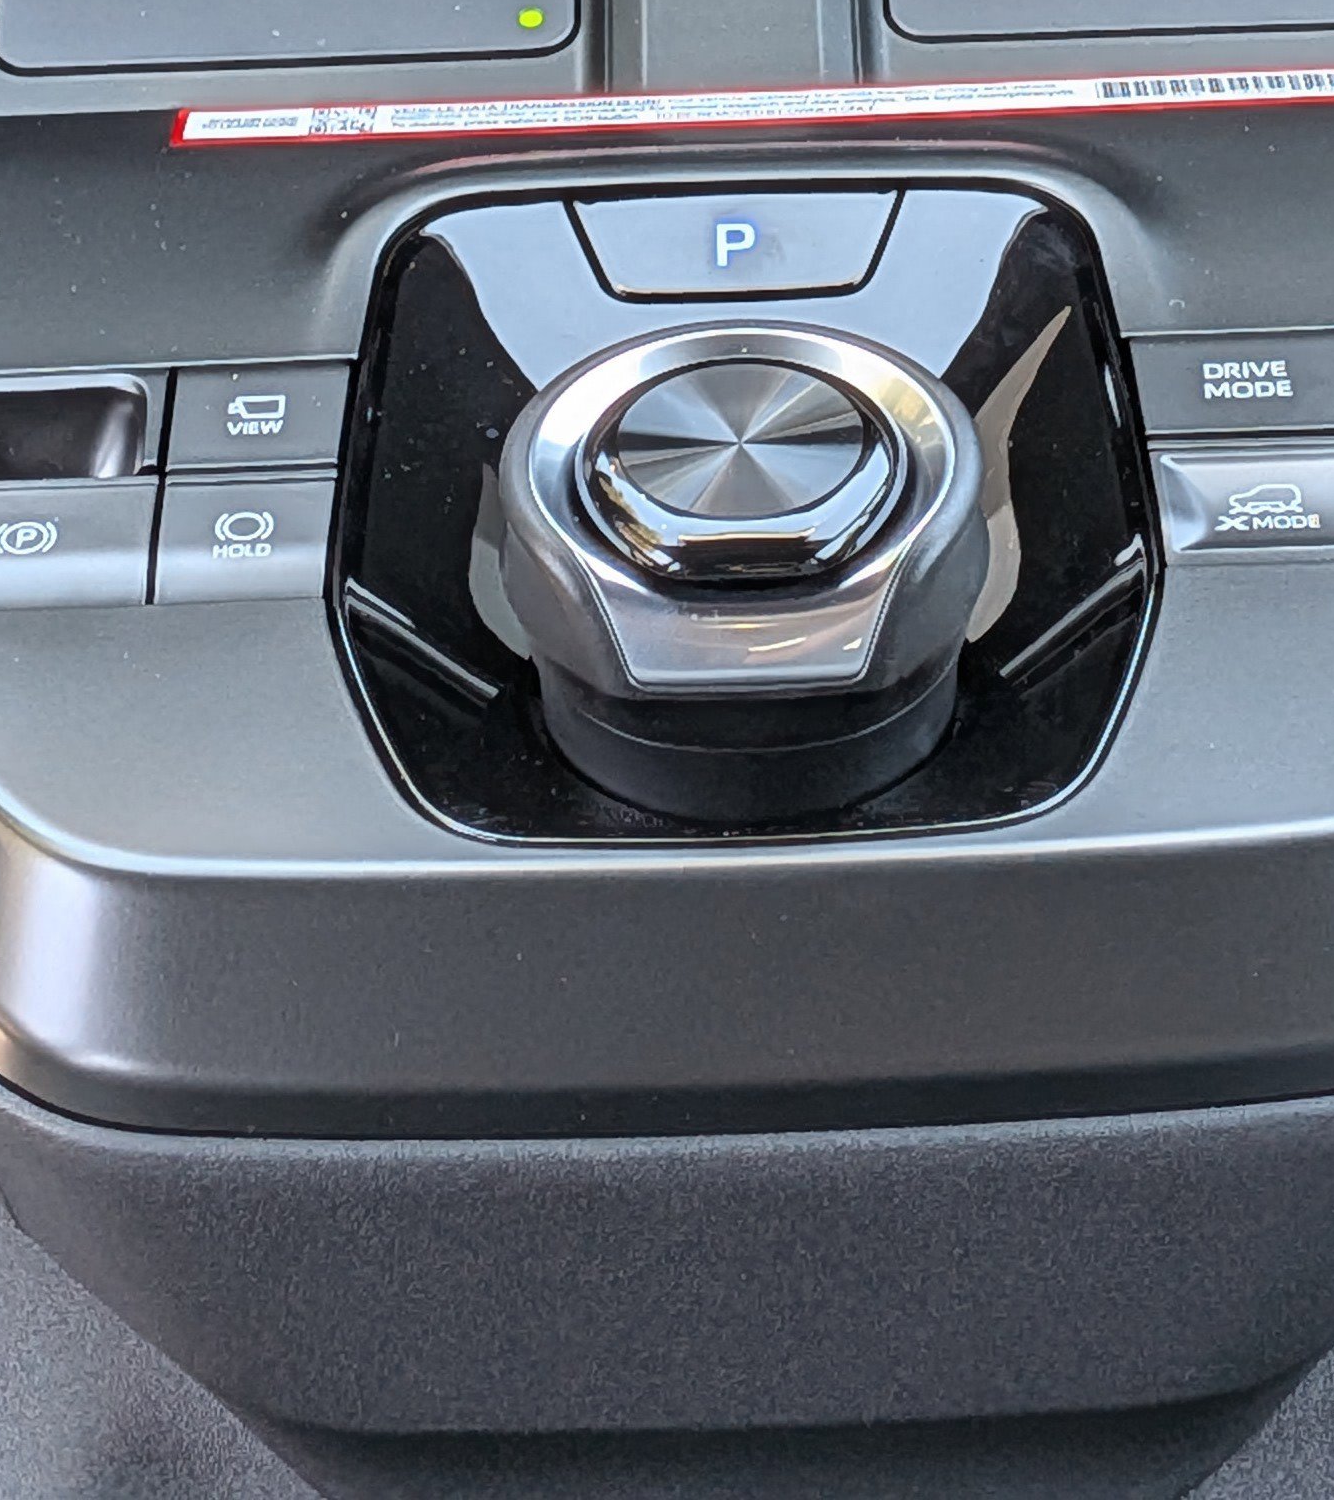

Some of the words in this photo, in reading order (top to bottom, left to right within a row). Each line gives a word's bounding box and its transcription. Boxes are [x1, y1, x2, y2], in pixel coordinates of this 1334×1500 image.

[715, 222, 756, 268] P
[1202, 360, 1288, 380] DRIVE
[1203, 378, 1294, 399] MODE
[226, 418, 284, 436] VIEW
[1252, 513, 1321, 531] MODE
[213, 543, 272, 560] HOLD
